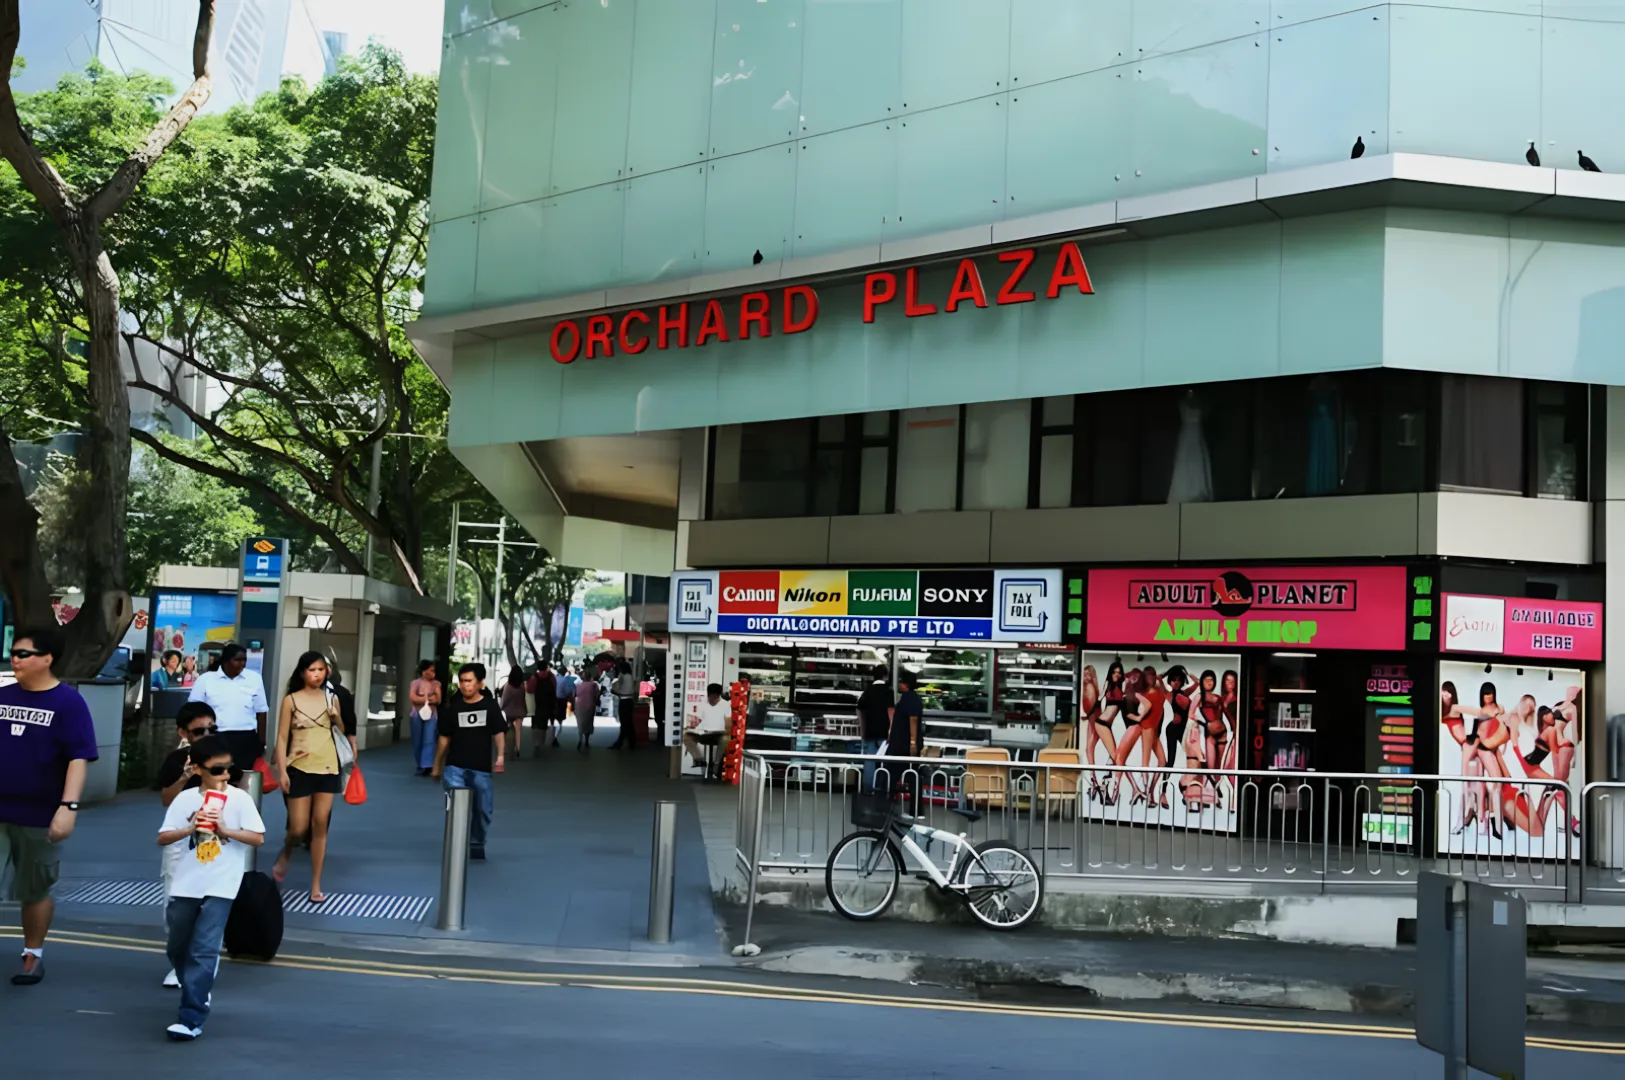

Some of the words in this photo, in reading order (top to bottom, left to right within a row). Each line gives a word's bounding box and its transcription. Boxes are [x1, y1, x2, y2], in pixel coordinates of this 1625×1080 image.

[549, 284, 819, 364] ORCHARD
[863, 242, 1095, 324] PLAZA
[723, 586, 776, 602] Canon
[784, 587, 841, 603] Nikon
[923, 588, 988, 603] SONY
[1137, 584, 1206, 604] ADULT
[1257, 584, 1348, 605] PLANET
[888, 620, 918, 634] PTE
[926, 620, 954, 635] LTD
[1154, 618, 1240, 643] ADULT
[1247, 620, 1318, 644] HOP
